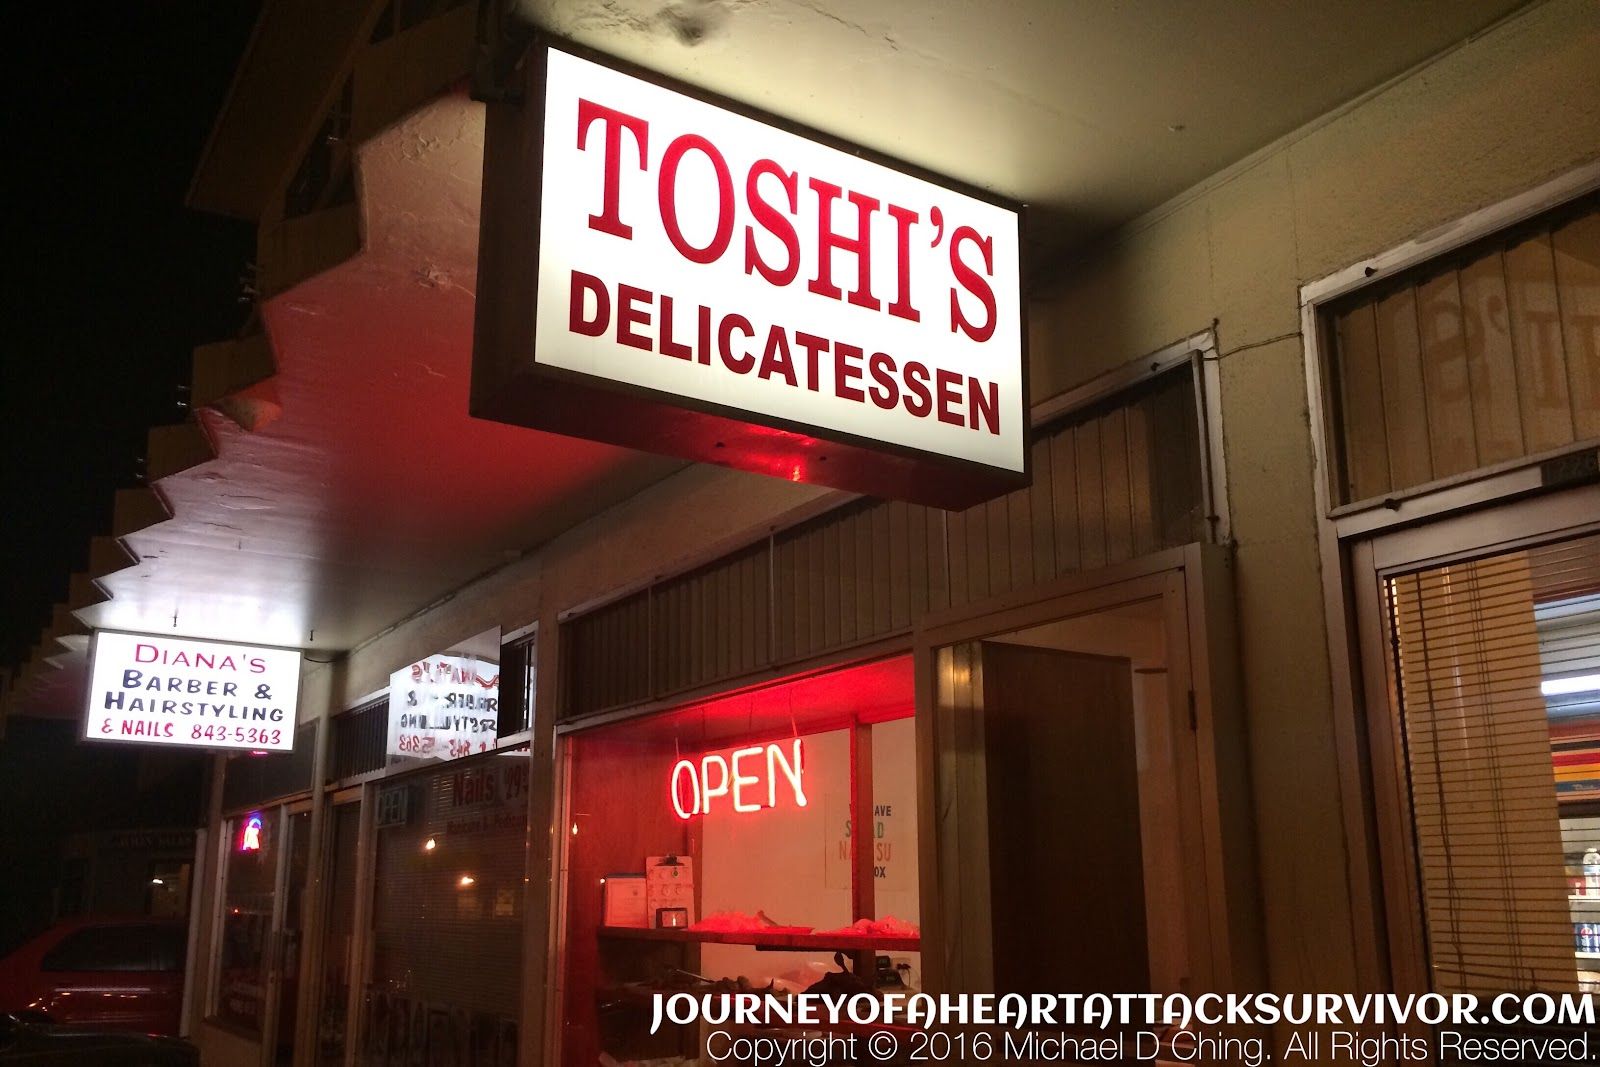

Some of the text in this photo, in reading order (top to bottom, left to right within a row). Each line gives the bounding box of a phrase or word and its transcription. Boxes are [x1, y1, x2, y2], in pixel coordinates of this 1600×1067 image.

[576, 97, 998, 343] TOSHI'S
[568, 269, 1001, 436] DELICATESSEN
[122, 669, 273, 700] BARBER &
[104, 691, 284, 722] HAIRSTYLING
[121, 719, 174, 738] NAILS
[191, 723, 281, 745] 843-5363
[452, 767, 494, 807] Nails
[671, 739, 807, 820] OPEN
[873, 805, 892, 818] AVE
